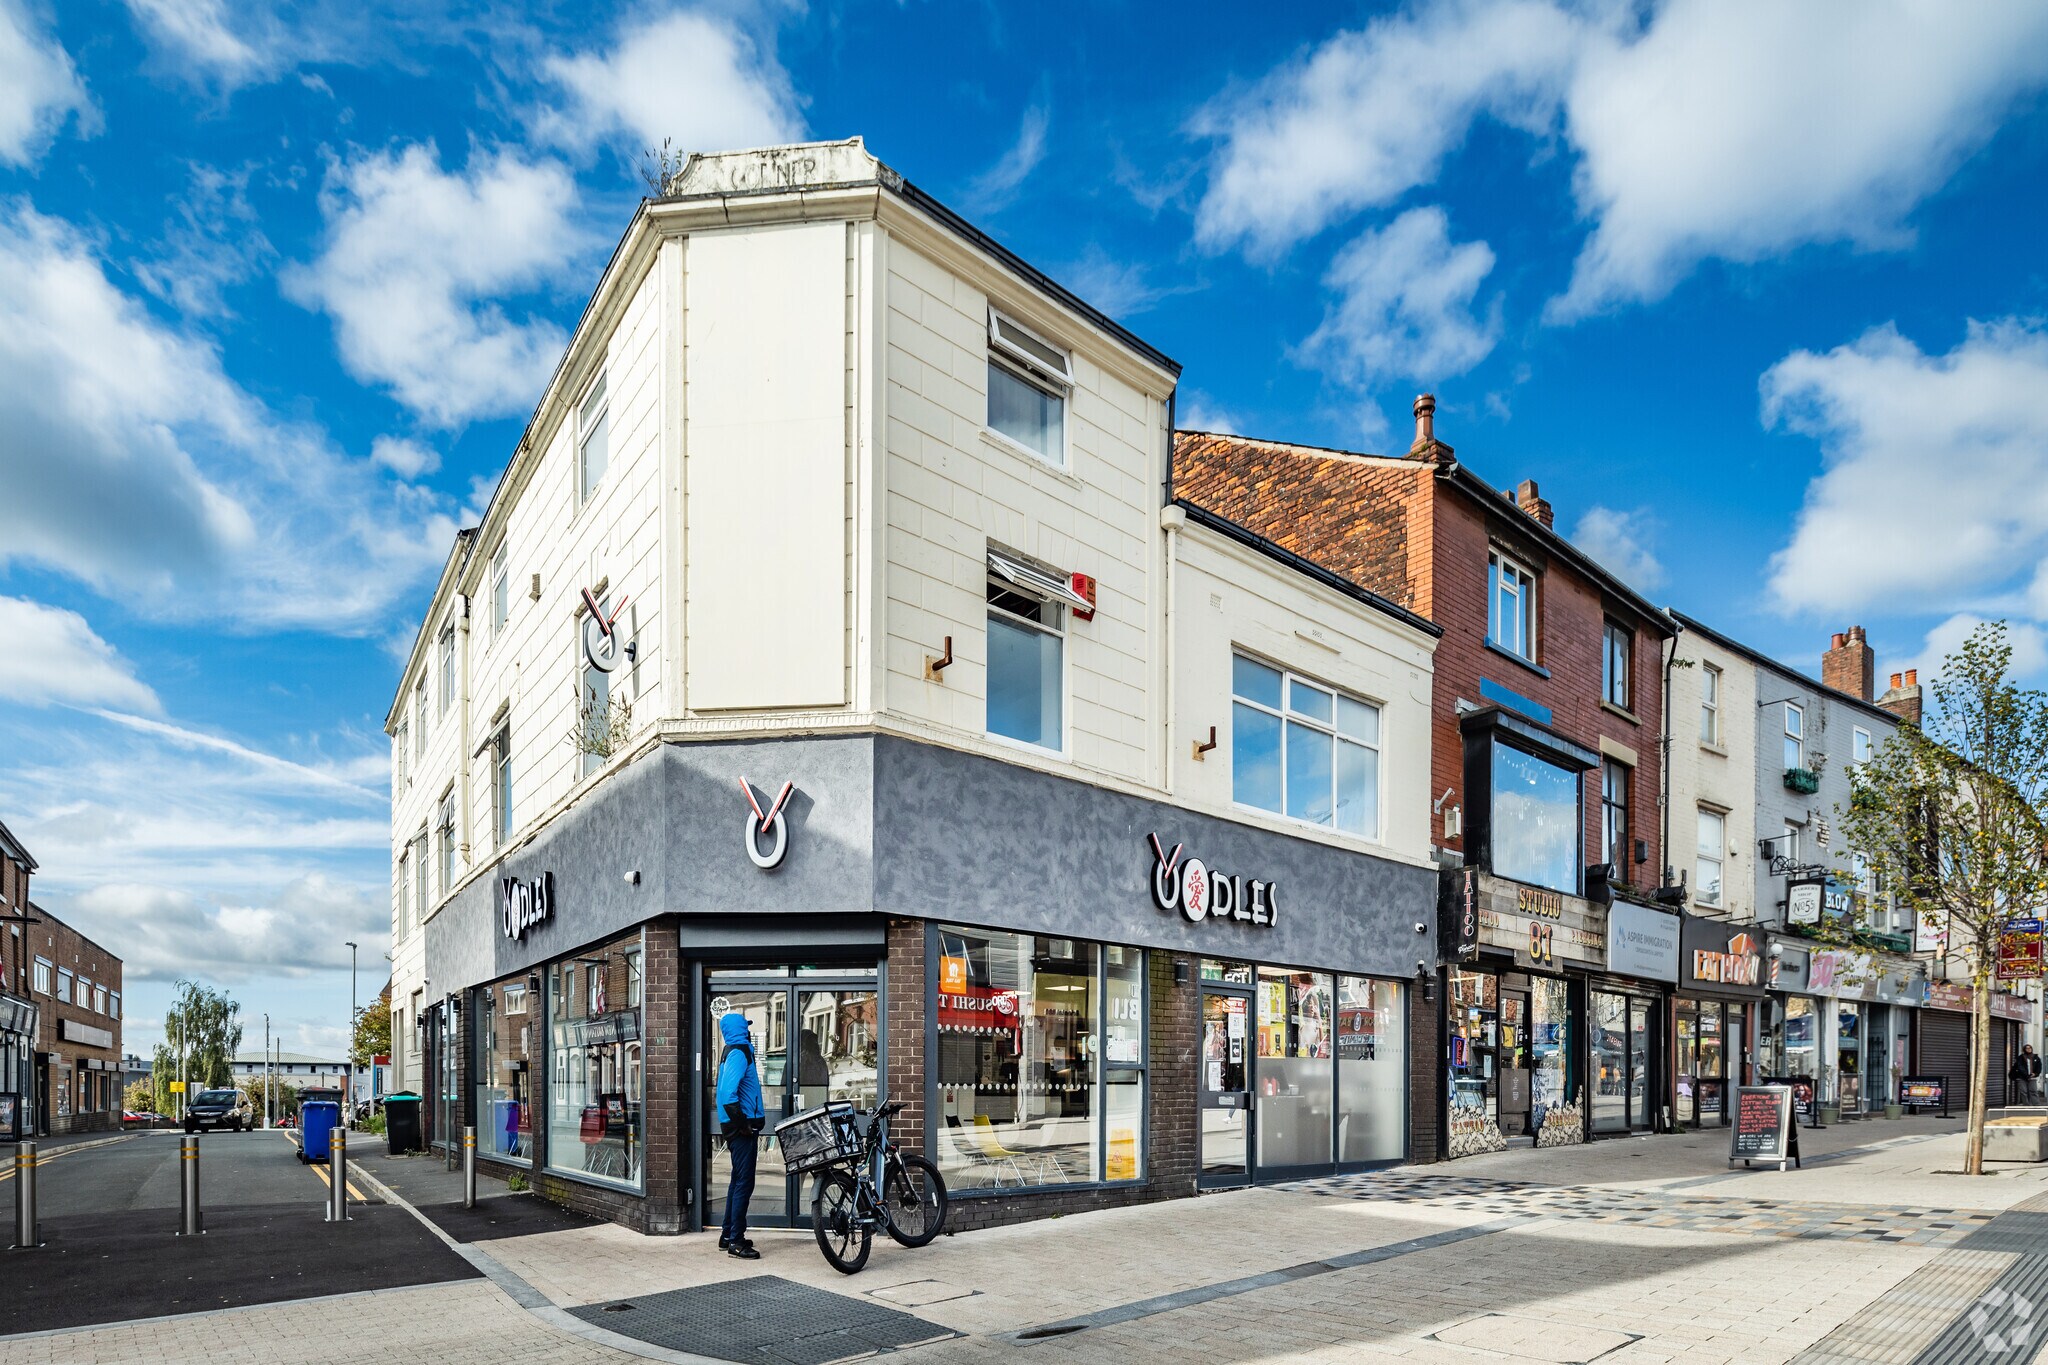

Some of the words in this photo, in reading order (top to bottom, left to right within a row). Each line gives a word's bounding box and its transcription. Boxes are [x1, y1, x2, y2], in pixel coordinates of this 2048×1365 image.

[1463, 870, 1475, 937] TATTOO
[1519, 887, 1561, 920] STUDIO
[1529, 921, 1553, 967] 81
[1627, 931, 1644, 945] ASPIRE
[1644, 934, 1673, 950] IMMIGRATION
